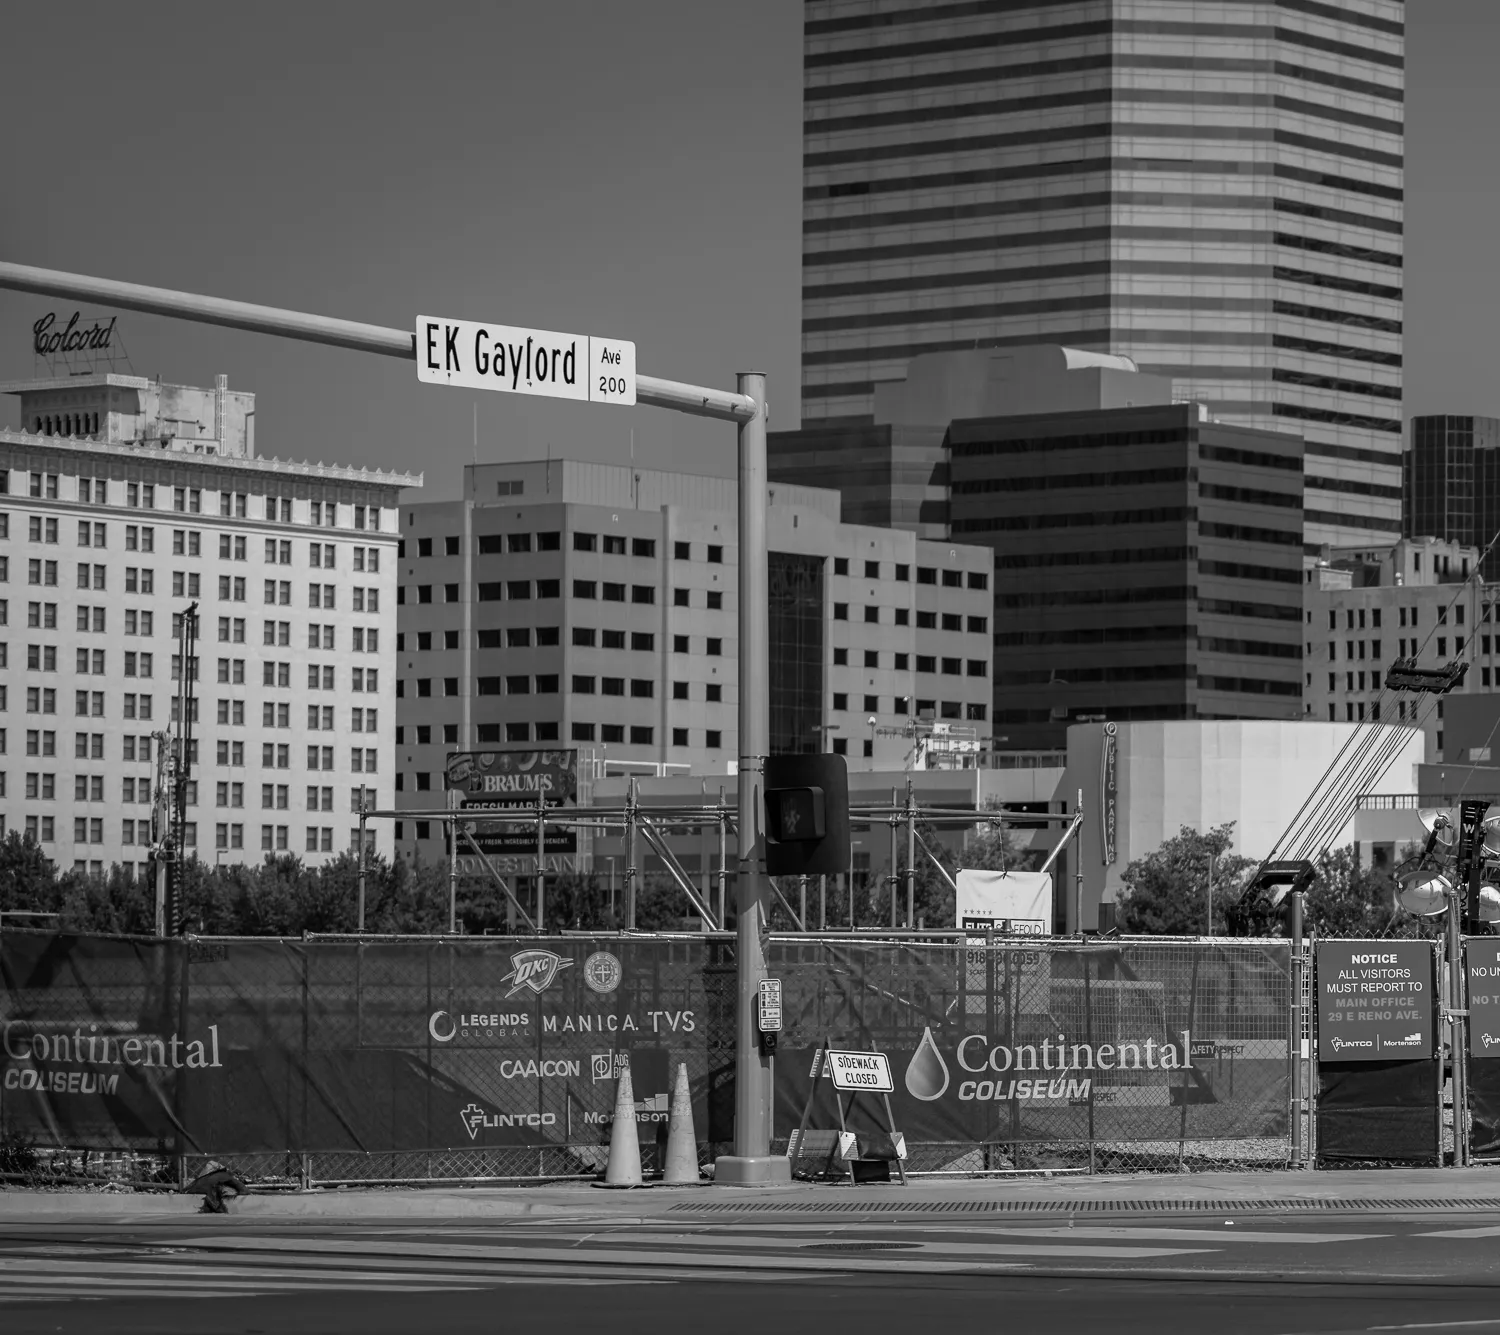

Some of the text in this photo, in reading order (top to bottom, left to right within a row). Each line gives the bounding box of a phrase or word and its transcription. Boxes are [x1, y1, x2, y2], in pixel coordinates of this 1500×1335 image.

[33, 311, 117, 356] Colcord
[426, 322, 461, 372] EK
[601, 346, 622, 365] Ave
[599, 376, 626, 395] 200
[1351, 954, 1398, 964] NOTICE
[514, 957, 549, 986] OKC
[1338, 968, 1411, 979] ALL VISITORS
[1471, 967, 1487, 977] NO
[1327, 982, 1423, 993] MUST REPORT TO
[1335, 997, 1415, 1008] MAIN OFFICE
[1472, 995, 1489, 1005] NO
[460, 1013, 530, 1027] LEGENDS
[647, 1010, 696, 1033] TVS
[1328, 1010, 1423, 1021] 29 E RENO AVE.
[461, 1028, 530, 1037] GLOBAL
[3, 1019, 223, 1069] Continental
[956, 1029, 1194, 1073] Continental
[613, 1054, 629, 1067] ADG
[837, 1055, 880, 1071] SIDEWALK
[4, 1068, 119, 1095] COLISEUM
[845, 1072, 878, 1085] CLOSED
[957, 1078, 1092, 1101] COLISEUM
[469, 1113, 556, 1128] FLINTCO
[583, 1111, 669, 1124] Mornson
